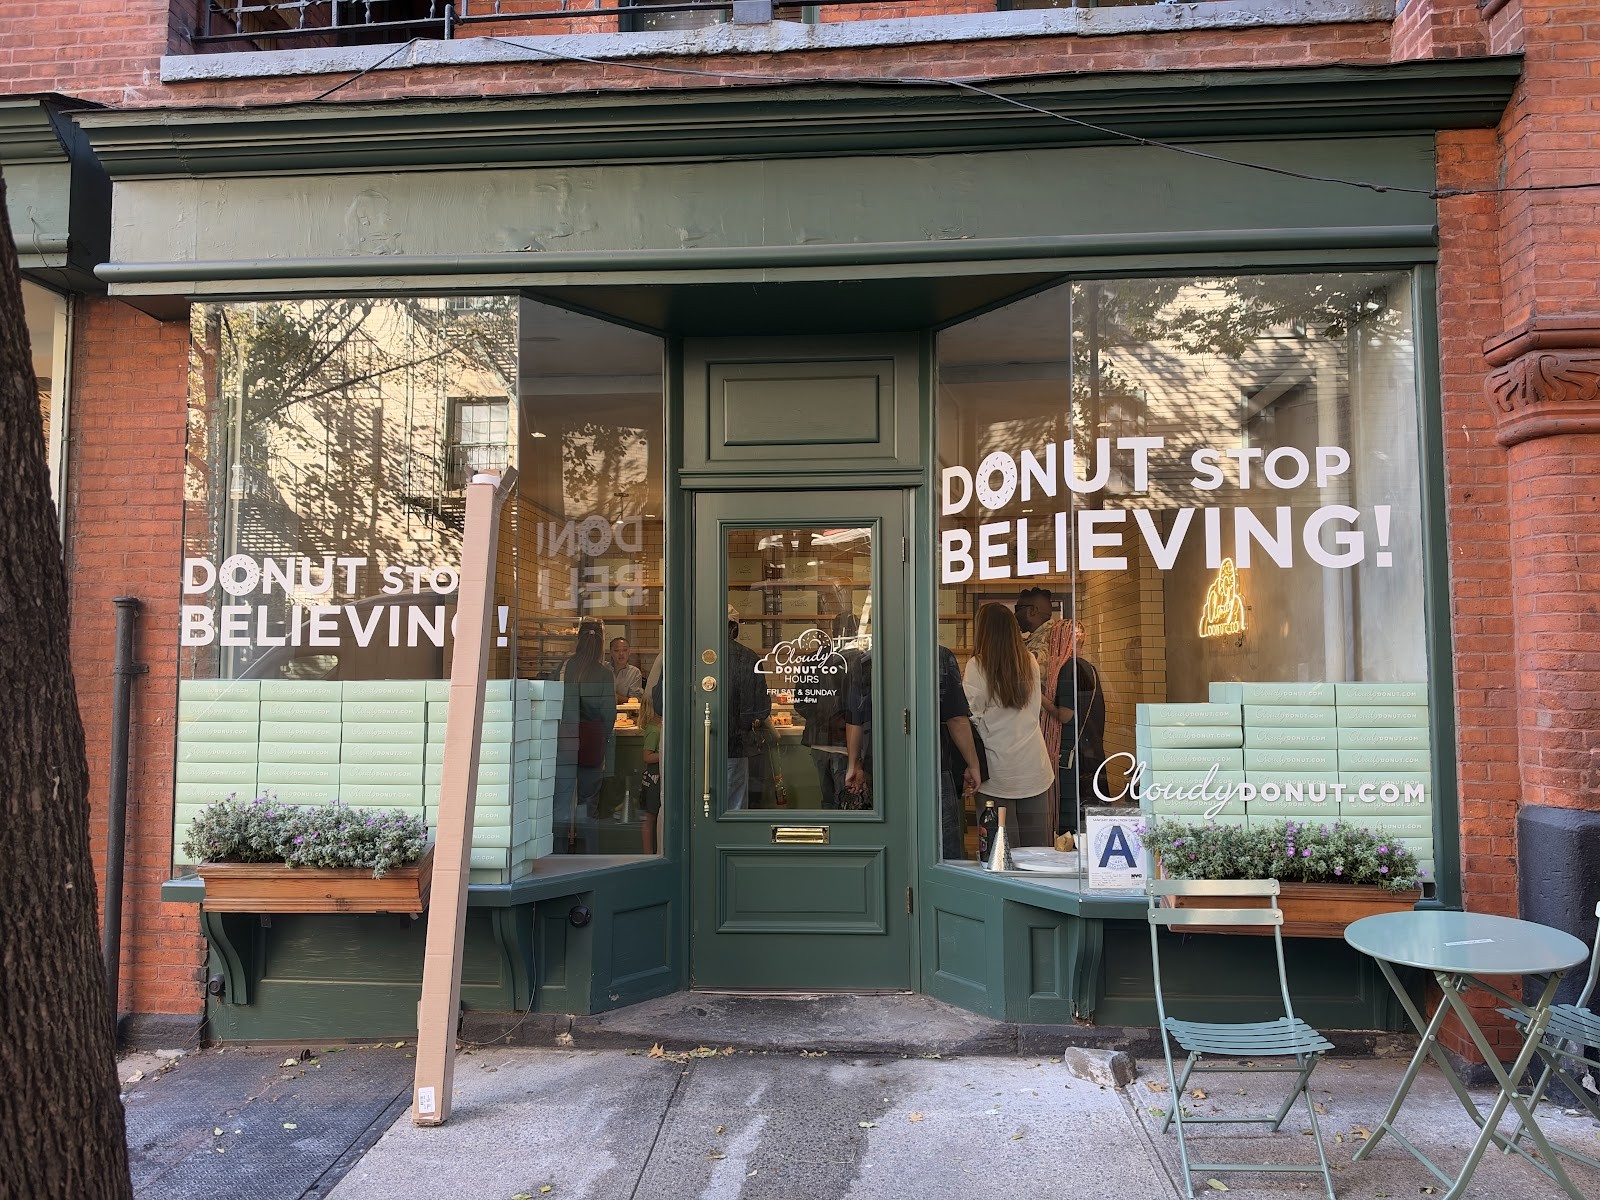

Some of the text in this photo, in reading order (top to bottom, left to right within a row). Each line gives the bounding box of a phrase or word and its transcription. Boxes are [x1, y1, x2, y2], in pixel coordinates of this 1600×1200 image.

[942, 437, 1350, 515] DONUT STOP
[941, 504, 1393, 584] BELIEVING!
[183, 554, 459, 596] DONUT STO
[181, 605, 508, 647] BELIEVIN!
[775, 645, 830, 668] Cloudy
[775, 665, 838, 674] DONUT CO
[784, 675, 820, 684] HOURS
[797, 688, 803, 696] &
[804, 688, 837, 697] SUNDAY
[1092, 752, 1425, 819] CloudyDONUT.COM
[1098, 826, 1138, 868] A
